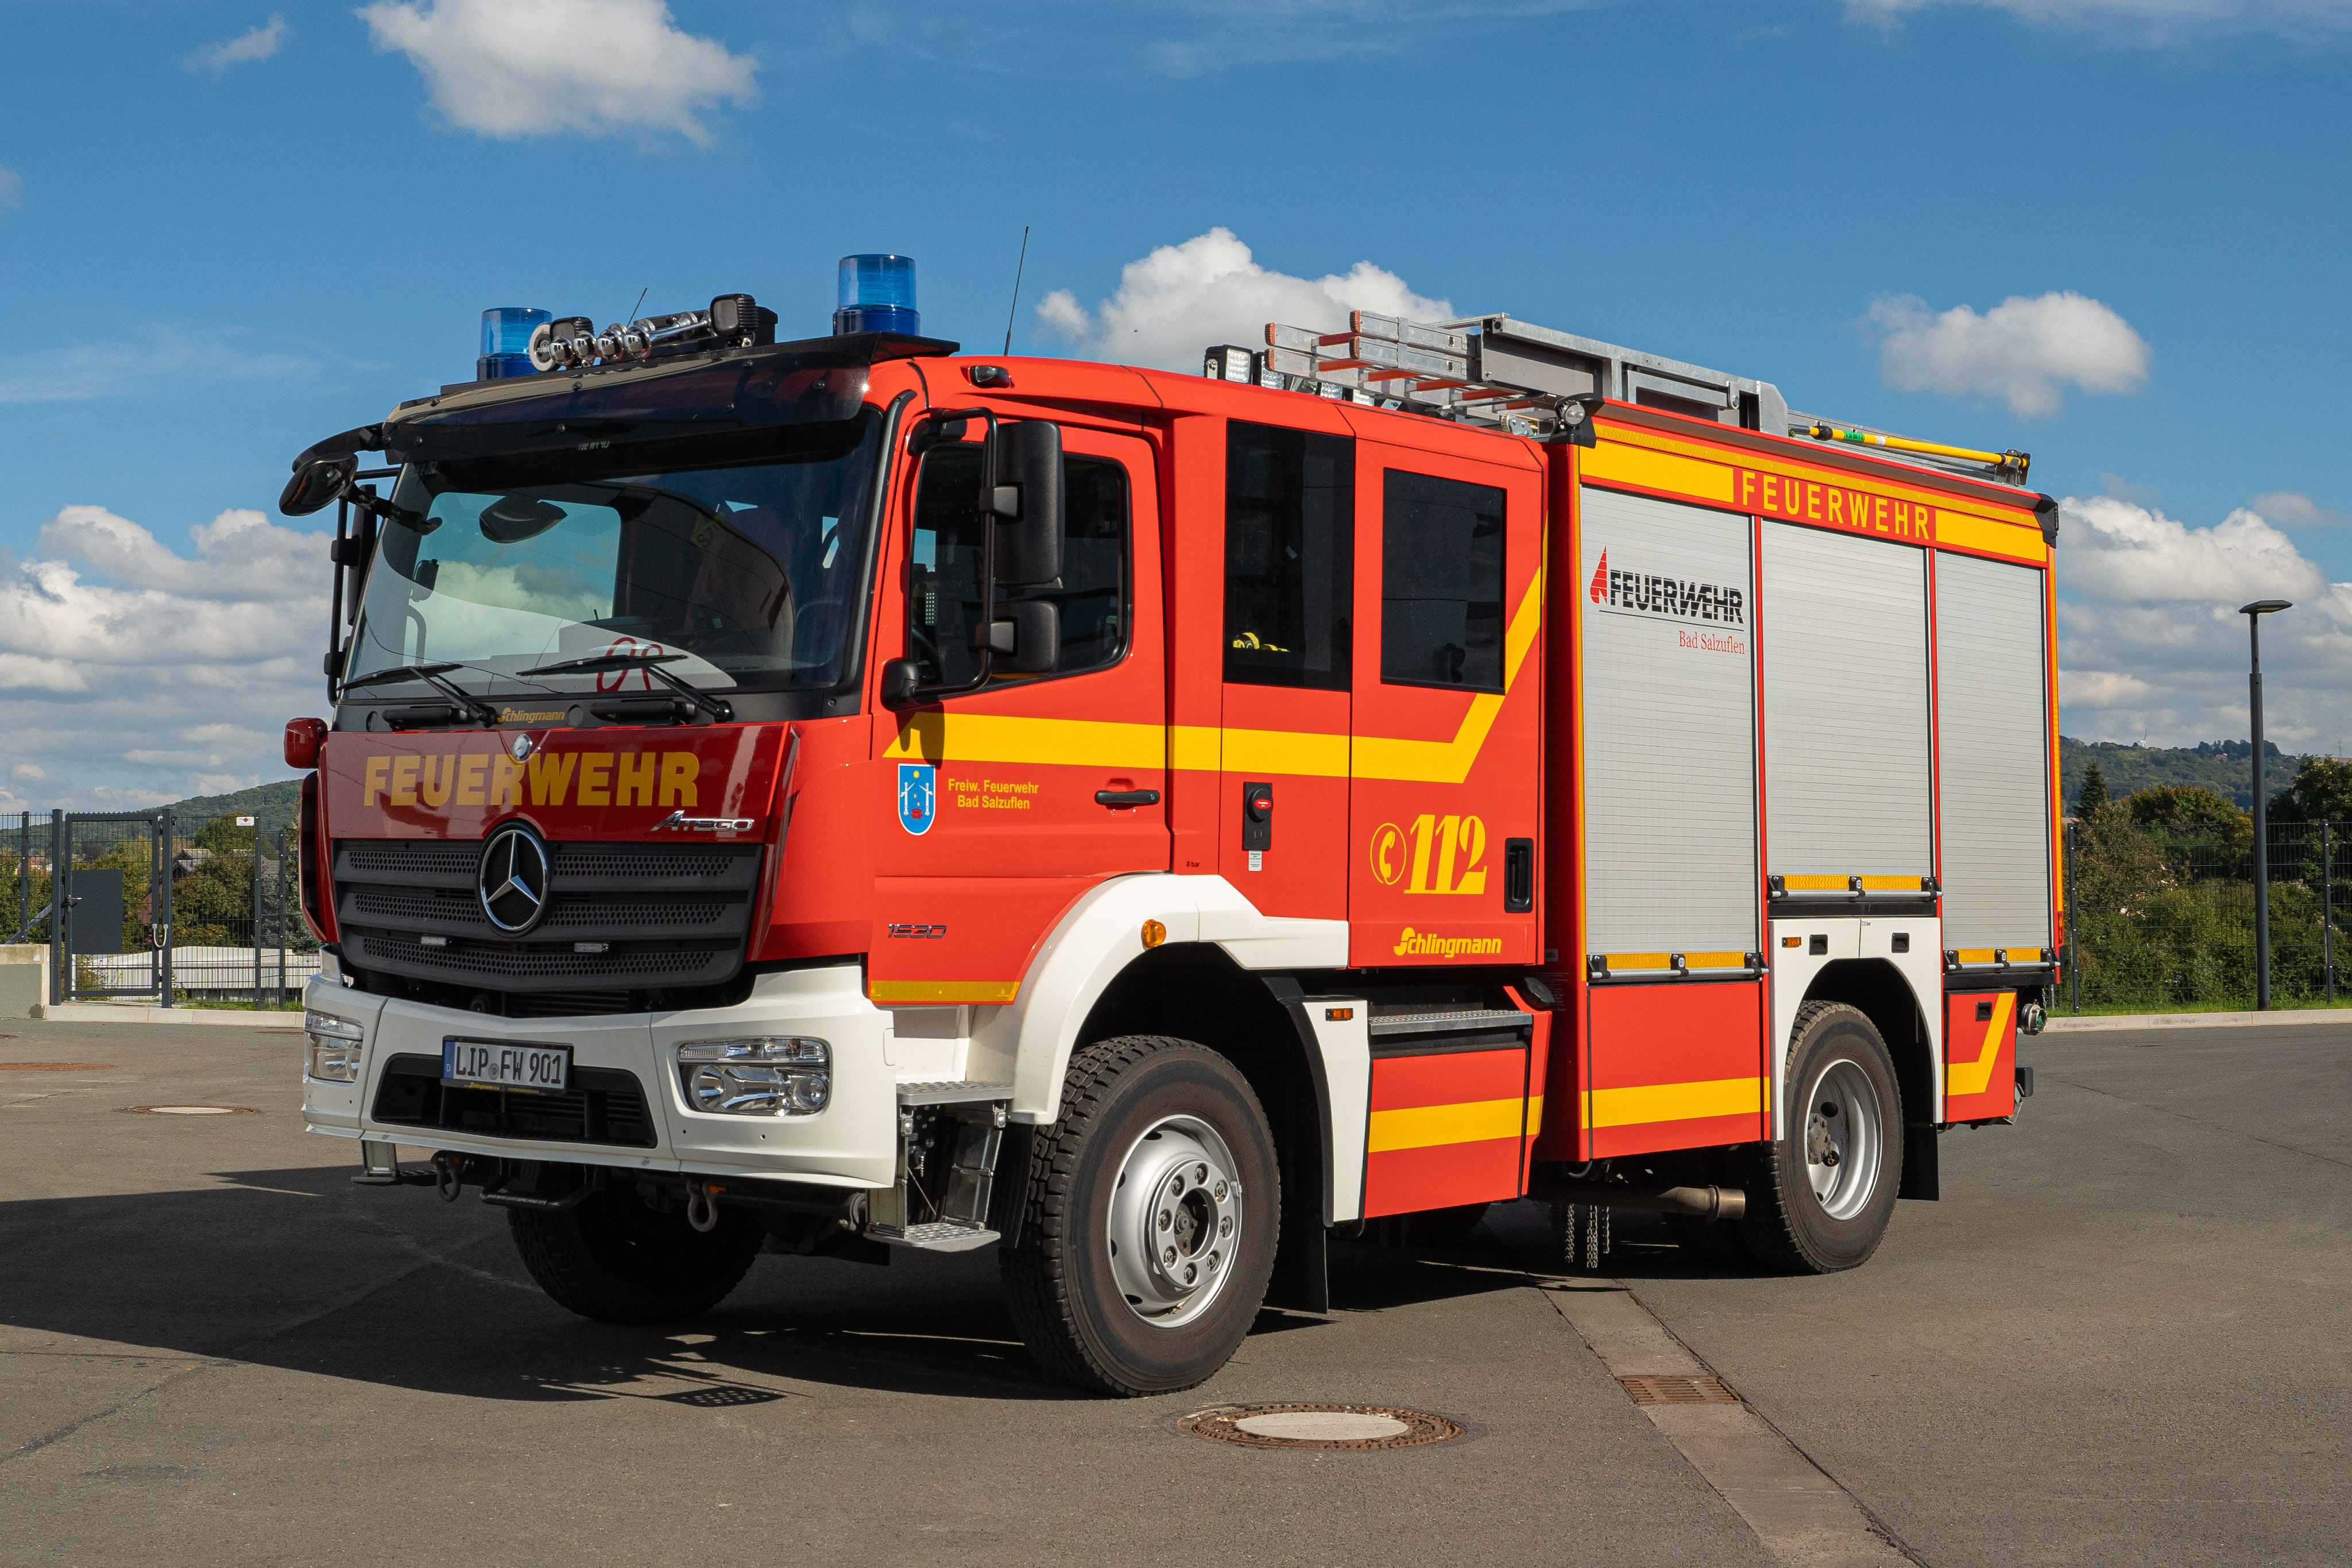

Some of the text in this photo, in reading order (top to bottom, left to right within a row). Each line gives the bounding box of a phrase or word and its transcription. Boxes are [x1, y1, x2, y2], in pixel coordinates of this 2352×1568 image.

[1742, 471, 1930, 540] FEUERWEHR
[1610, 569, 1744, 624] FEUERWEHR
[1679, 630, 1746, 655] Bad Salzuflen
[497, 707, 565, 723] Schlingmann
[363, 752, 700, 807] FEUERWEHR
[948, 778, 1039, 794] Freiw. Feuerwehr
[957, 795, 1030, 810] Bad Salzuflen
[1403, 814, 1488, 895] 112
[888, 923, 947, 938] 1530
[1394, 927, 1502, 958] Schlingmann
[446, 1063, 451, 1073] D
[455, 1046, 562, 1085] LIP FW 901
